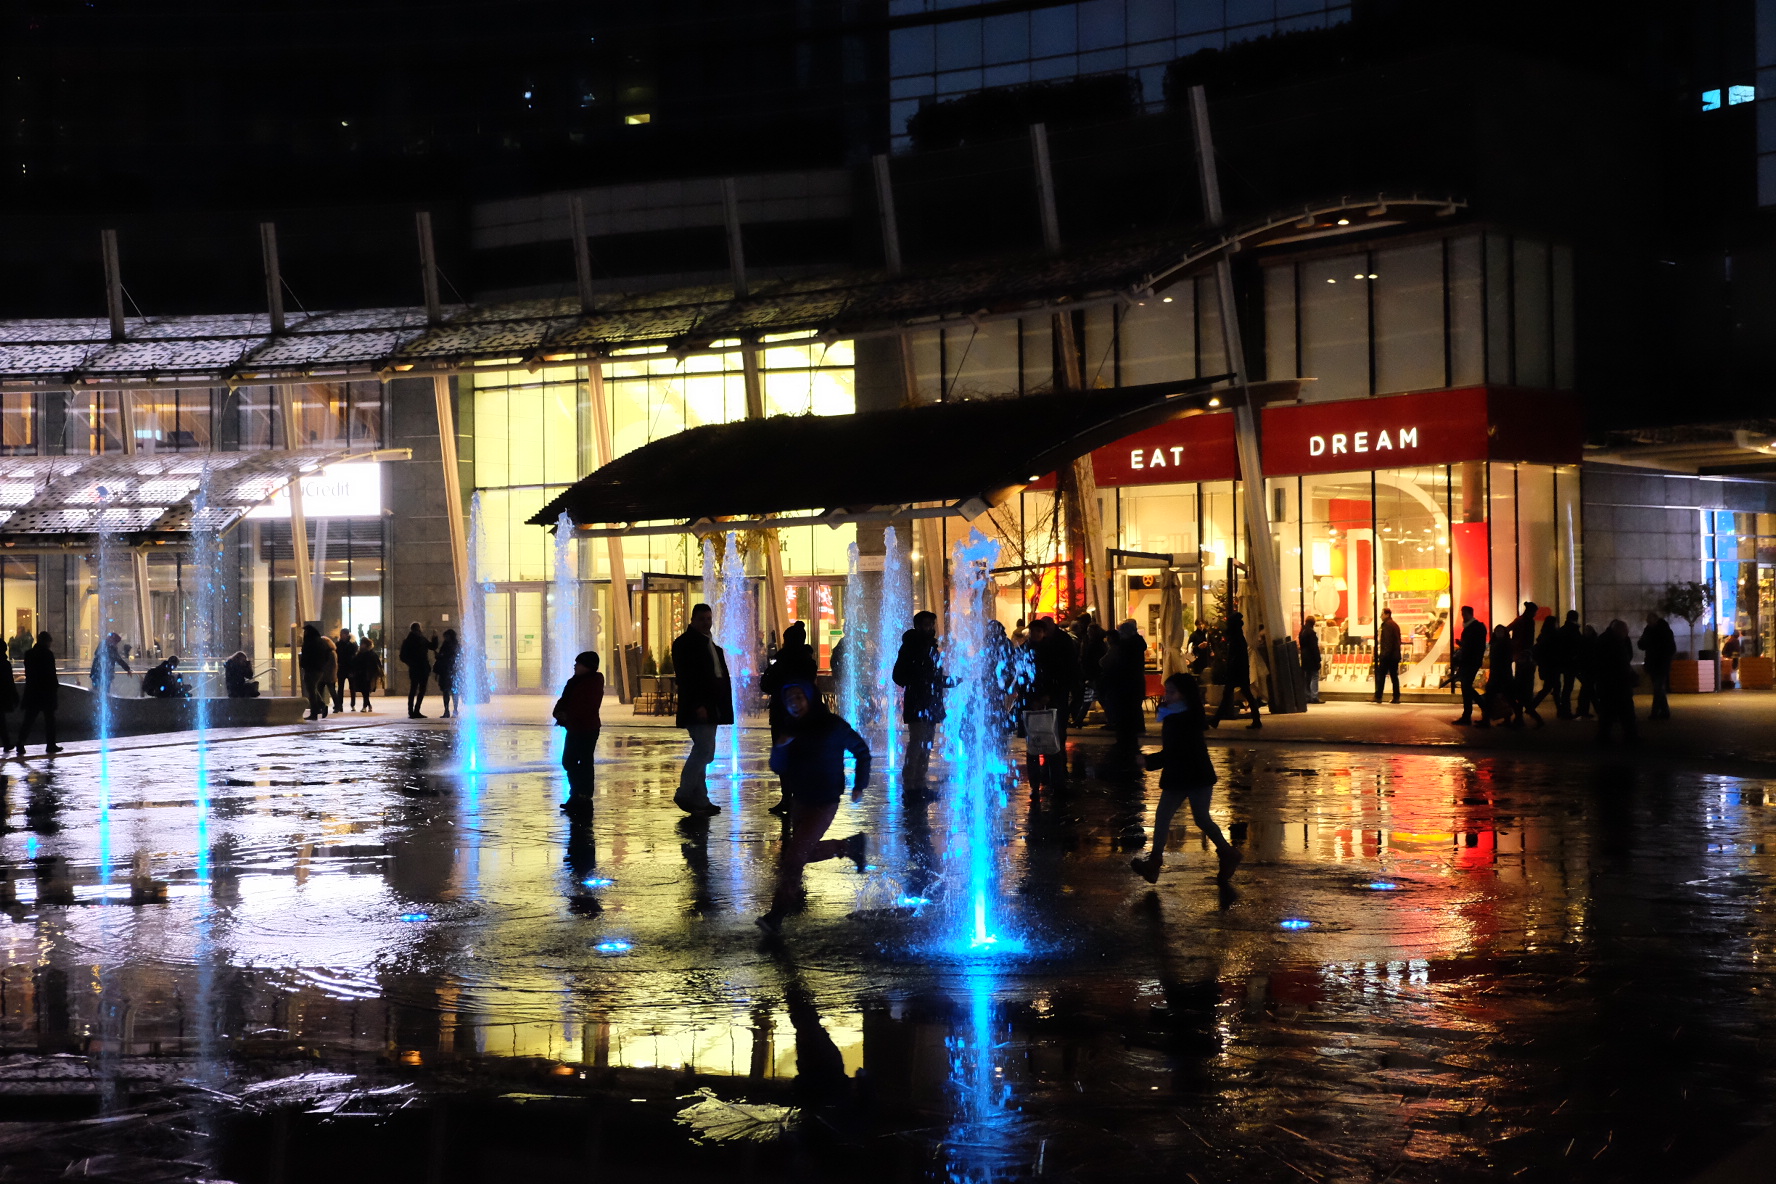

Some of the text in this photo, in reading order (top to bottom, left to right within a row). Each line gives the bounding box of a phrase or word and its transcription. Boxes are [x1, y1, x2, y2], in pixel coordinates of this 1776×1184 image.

[1309, 427, 1418, 456] DREAM
[1130, 446, 1185, 469] EAT
[282, 482, 349, 498] UiCredit
